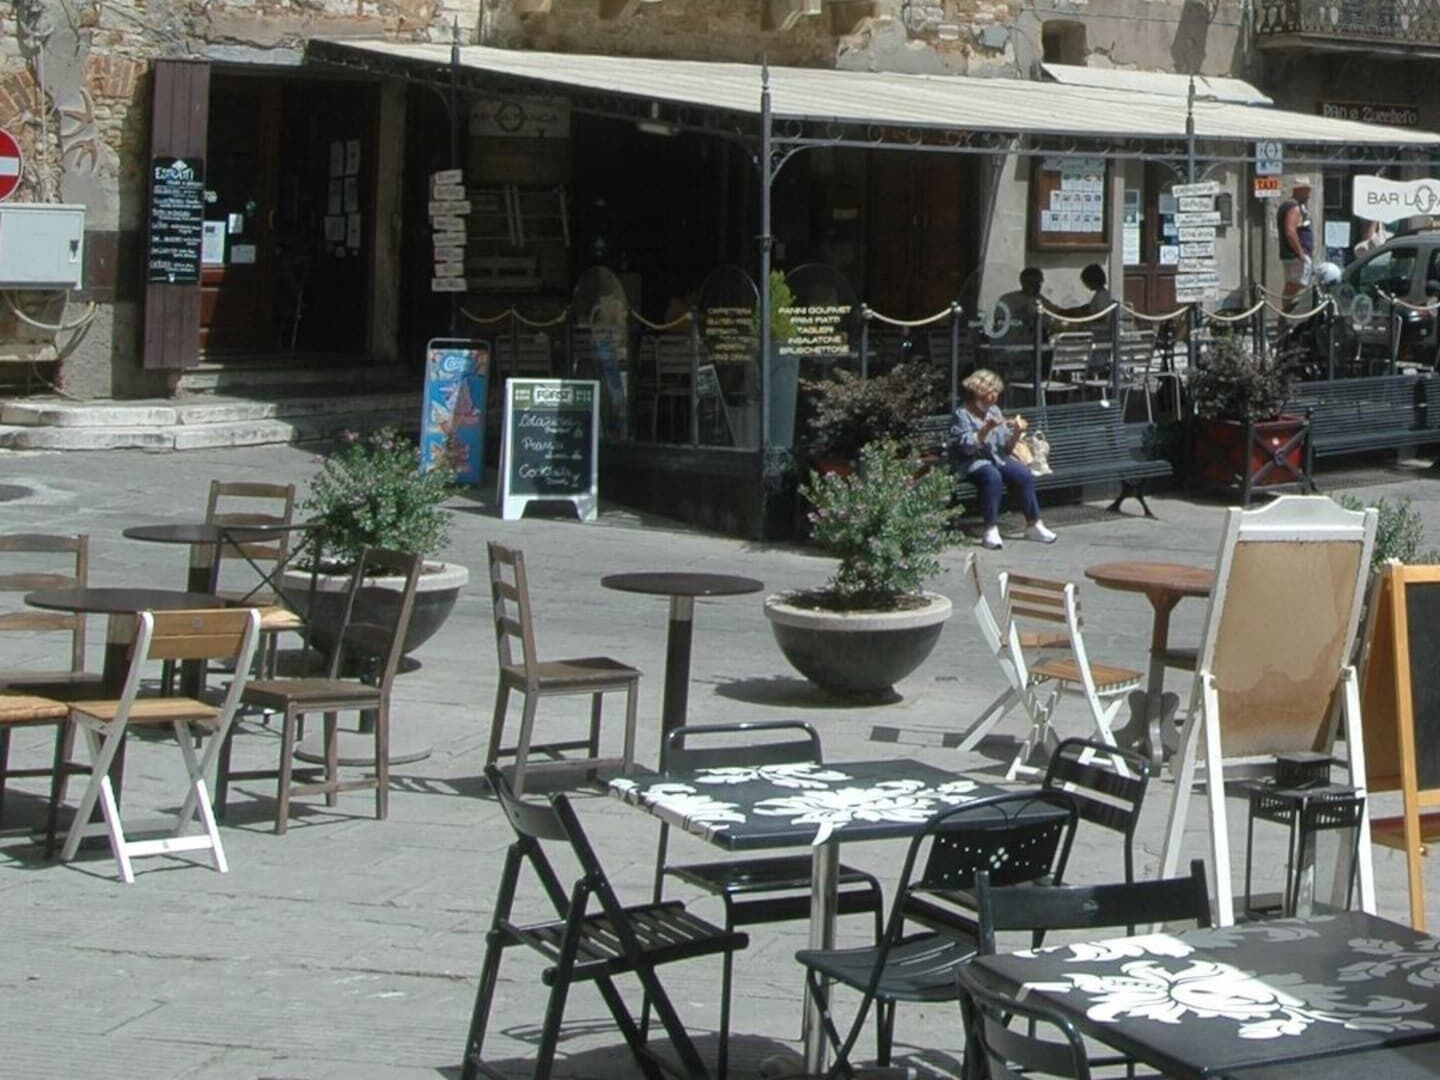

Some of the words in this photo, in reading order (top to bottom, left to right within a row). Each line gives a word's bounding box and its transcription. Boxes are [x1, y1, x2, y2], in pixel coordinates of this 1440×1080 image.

[1257, 179, 1278, 189] TAXI
[1367, 192, 1399, 205] BAR
[1404, 193, 1422, 206] LA
[808, 305, 852, 315] GOURMET
